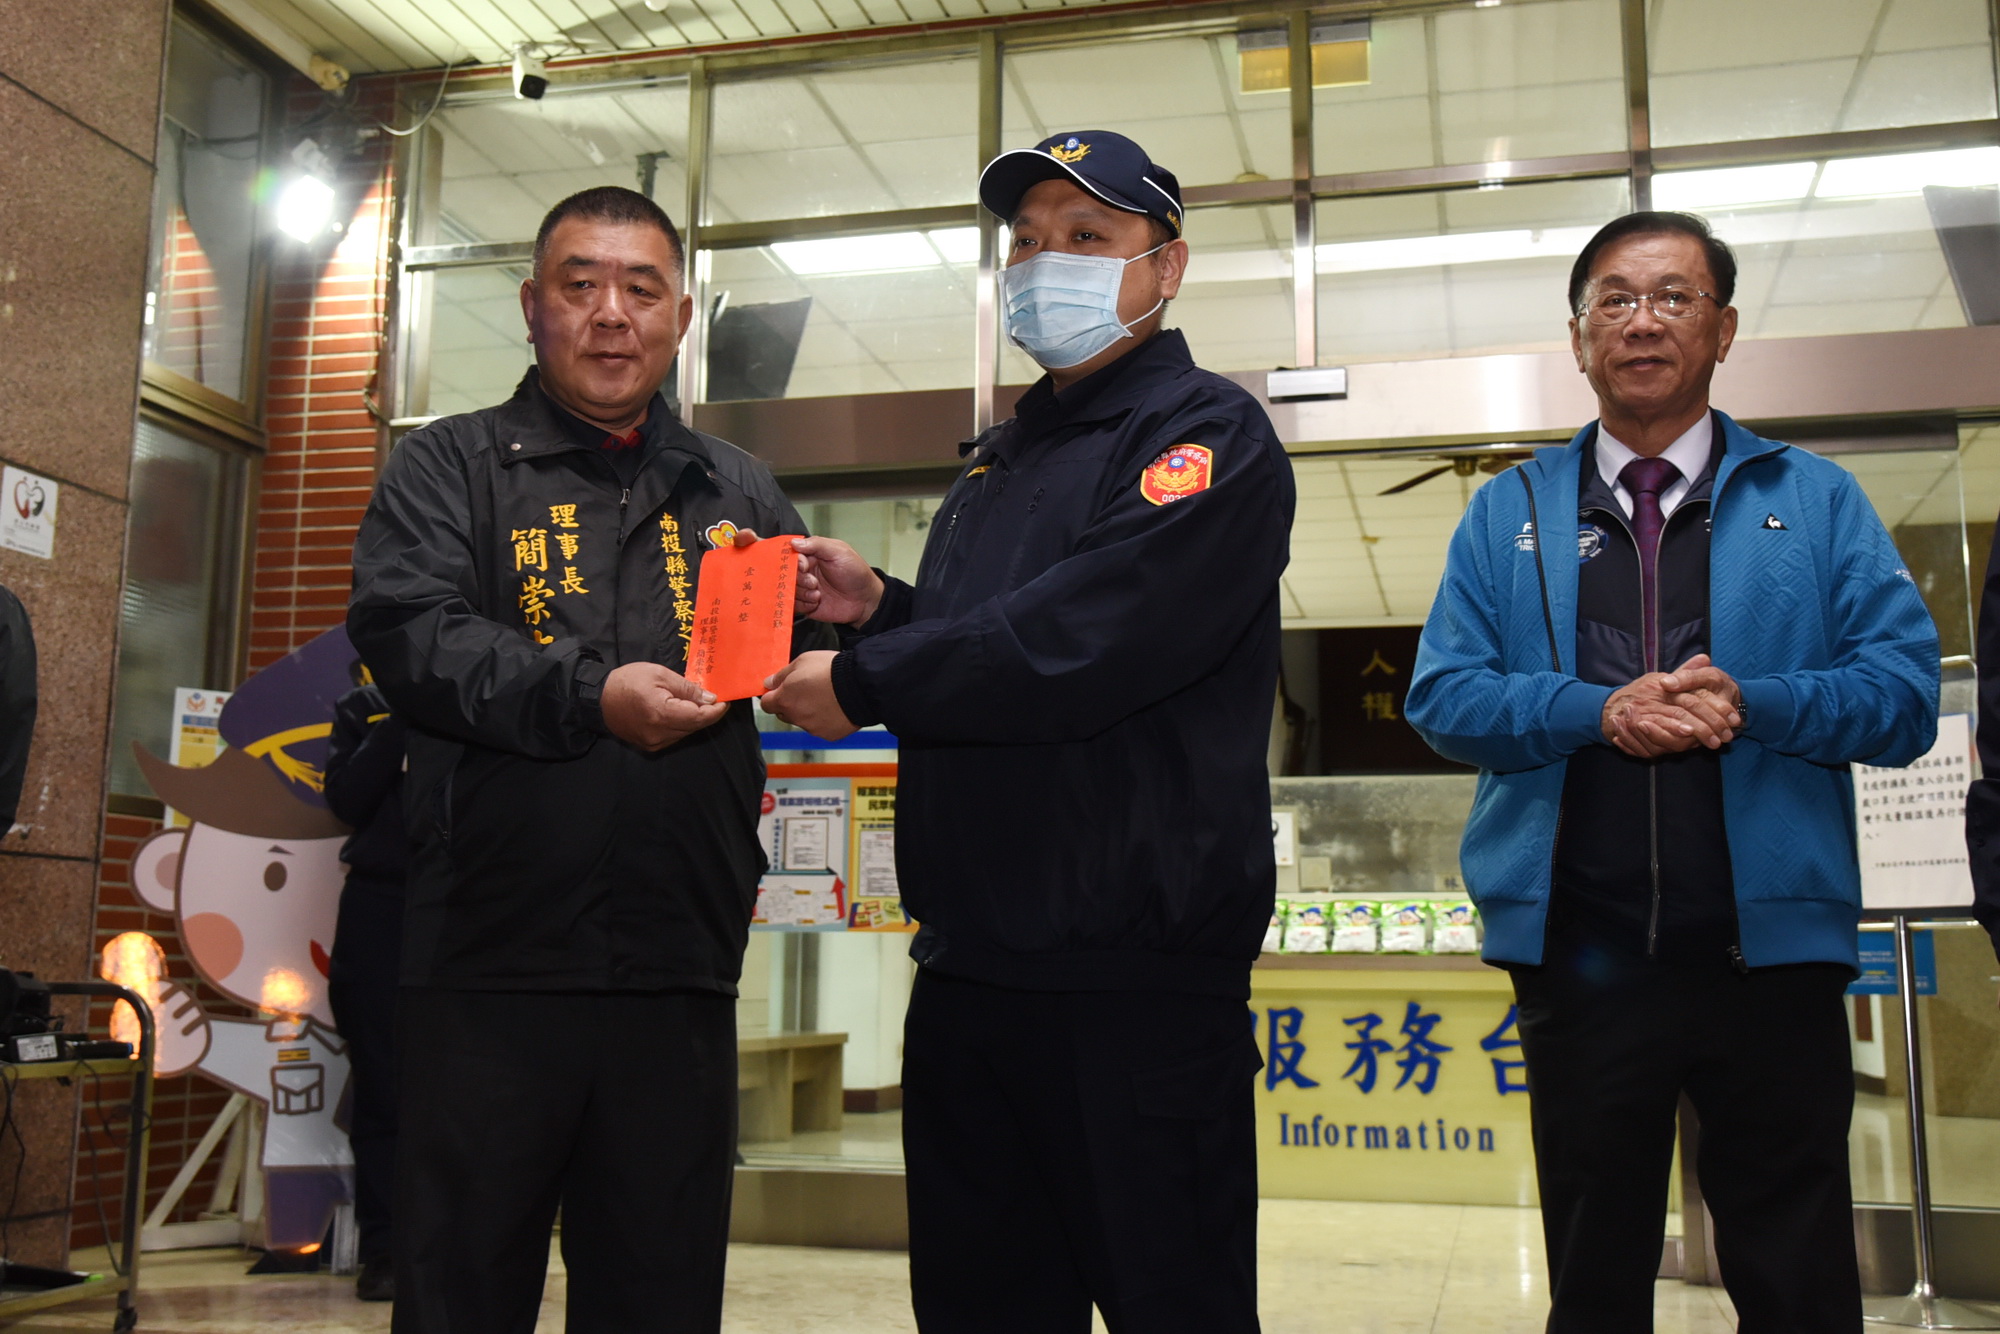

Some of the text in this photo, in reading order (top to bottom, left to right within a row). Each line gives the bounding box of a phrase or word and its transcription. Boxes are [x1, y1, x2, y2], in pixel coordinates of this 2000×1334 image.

[510, 528, 555, 645] 簡崇
[549, 503, 590, 594] 理事長
[706, 598, 720, 675] 南投縣警察之友會
[1361, 650, 1398, 721] 人權
[1279, 1113, 1494, 1152] Information
